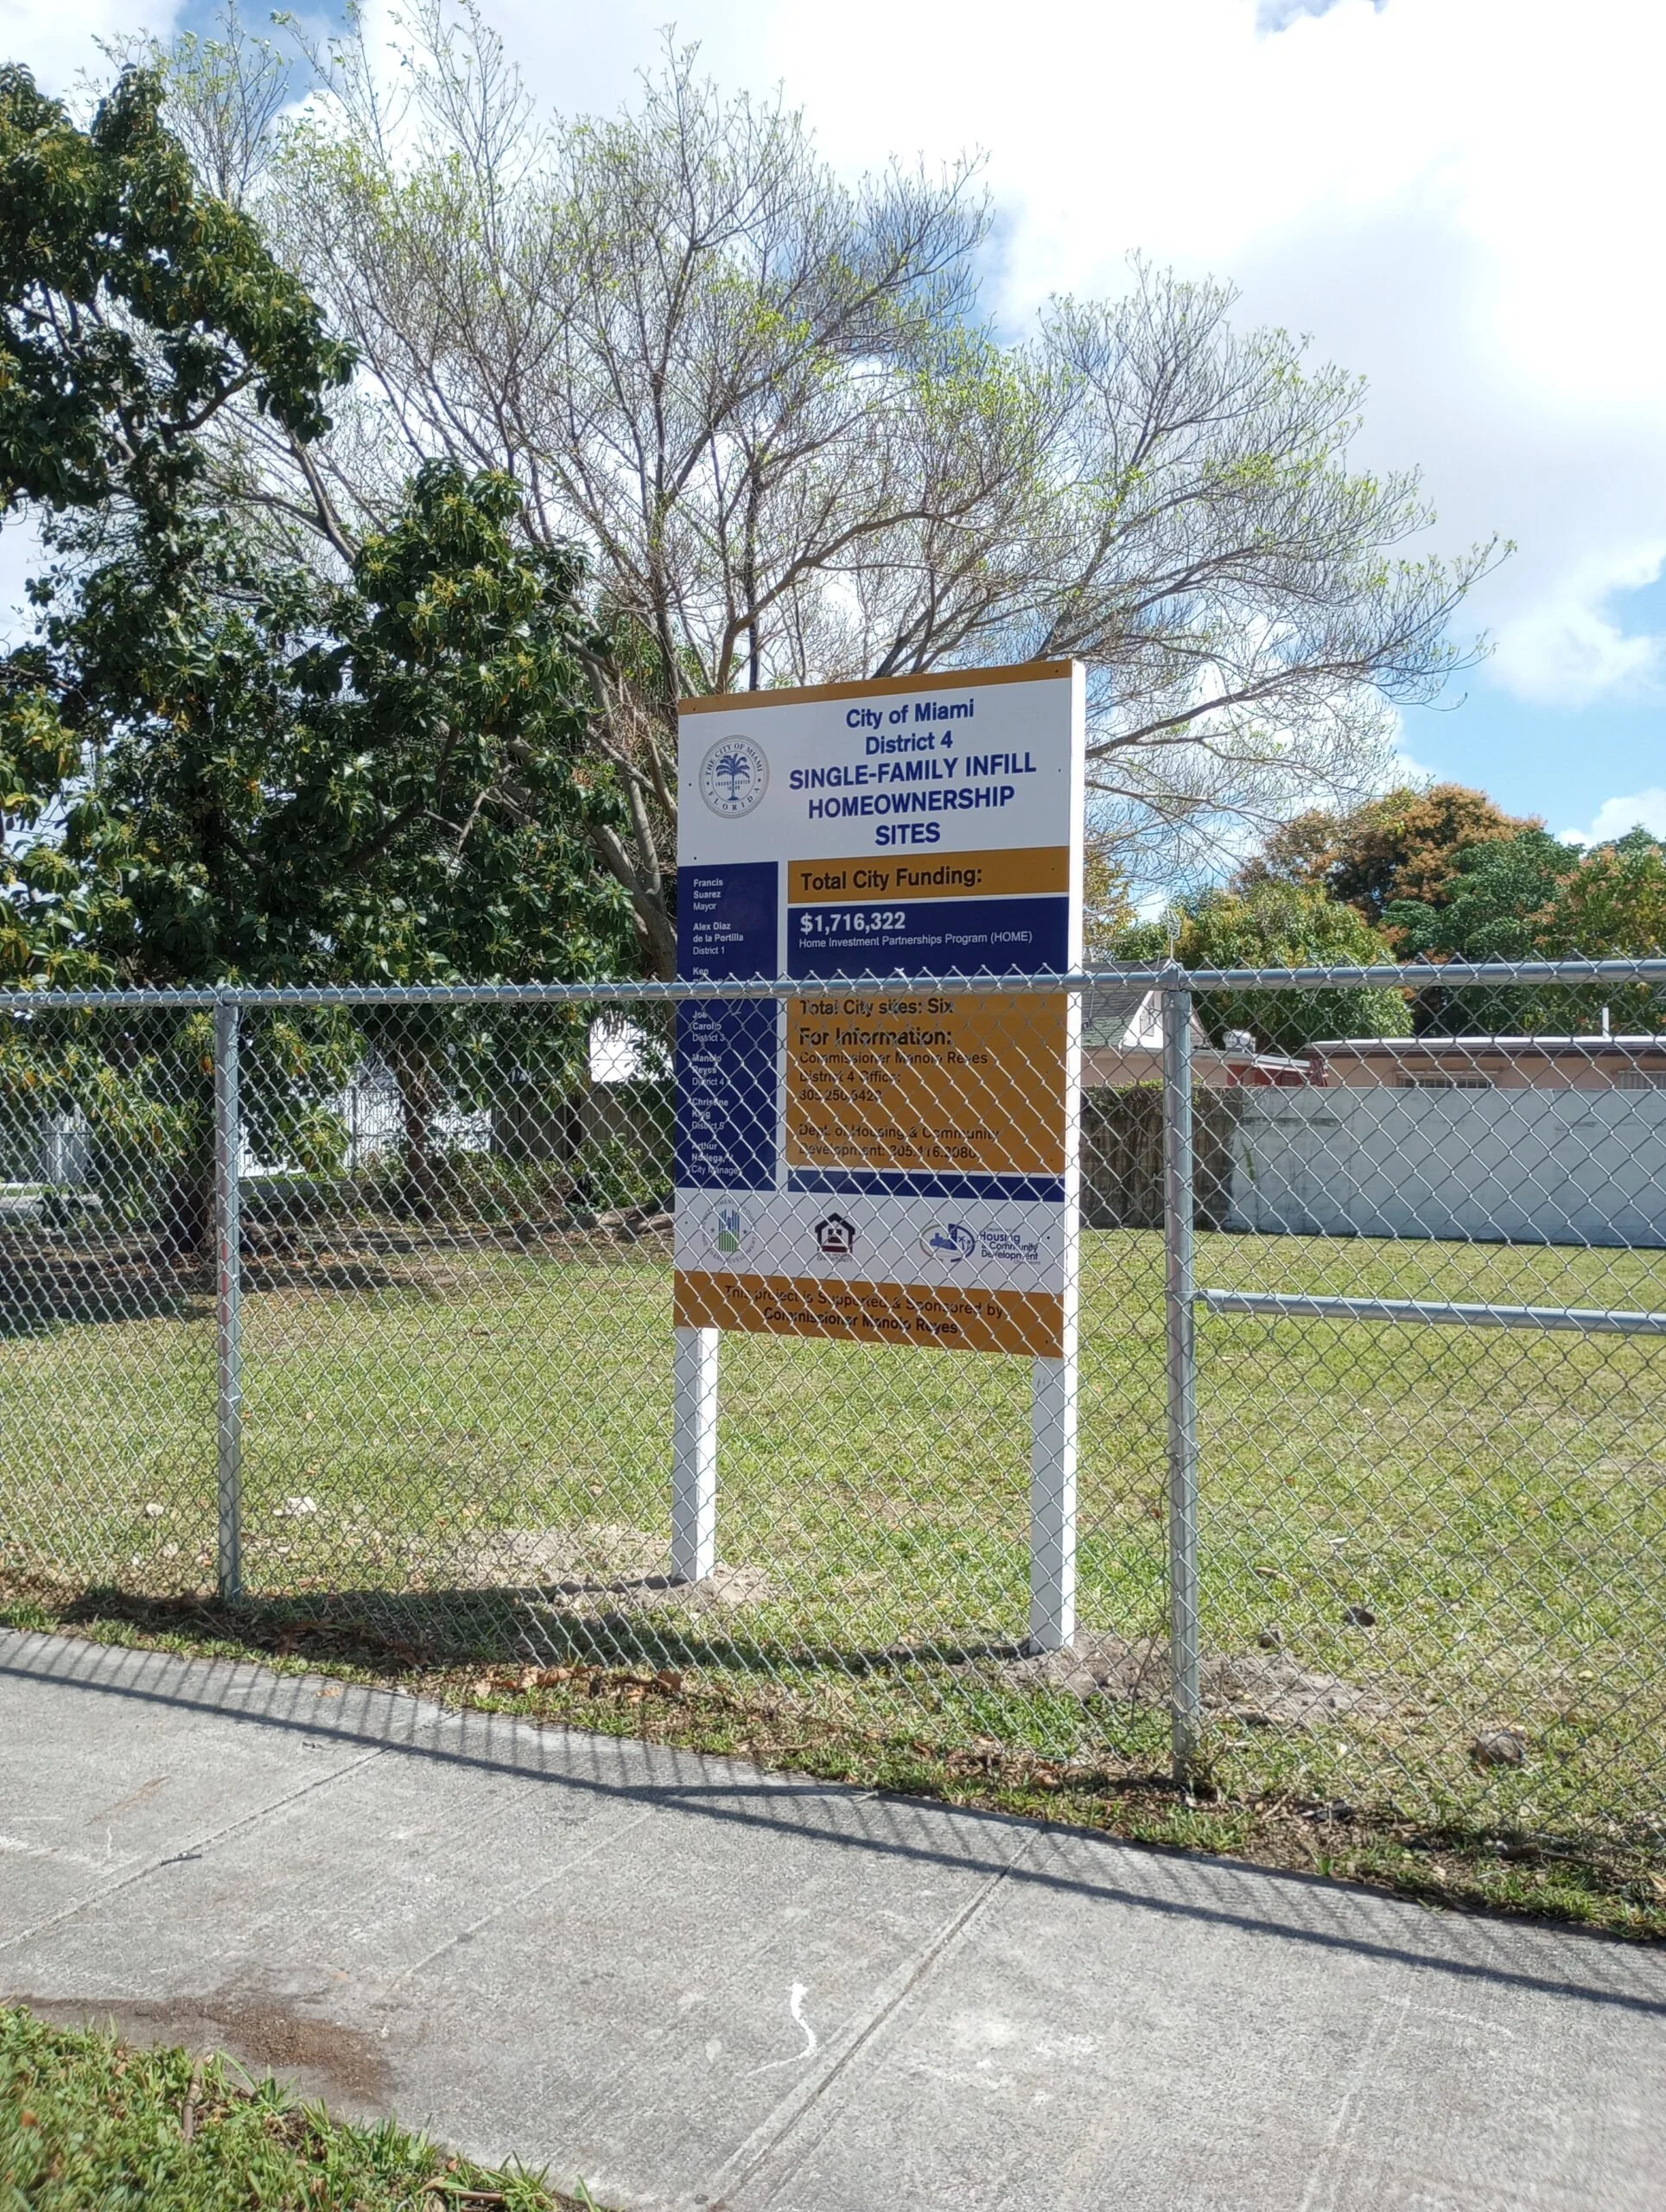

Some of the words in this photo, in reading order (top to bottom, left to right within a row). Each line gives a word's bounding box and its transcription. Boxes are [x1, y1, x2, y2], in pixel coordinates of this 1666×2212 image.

[846, 707, 883, 730] City
[888, 704, 909, 724] of
[914, 698, 975, 722] Miami
[866, 732, 935, 755] District
[940, 730, 953, 748] 4
[789, 757, 958, 790] SINGLE-FAMILY
[966, 752, 1037, 778] INFILL
[809, 785, 1014, 819] HOMEOWNERSHIP
[874, 822, 940, 846] SITES
[693, 878, 723, 887] Francis
[800, 871, 847, 891] Total
[853, 869, 889, 892] City
[896, 866, 982, 887] Funding:
[693, 902, 716, 912] Mayor
[799, 912, 906, 935] $1,716,322
[693, 934, 703, 943] de
[715, 933, 744, 942] Portilla
[799, 938, 826, 948] Home
[829, 937, 880, 947] Investment
[881, 934, 942, 946] Partnerships
[944, 932, 988, 945] Program
[990, 931, 1033, 944] (HOME)
[693, 946, 719, 955] District
[693, 967, 709, 976] Ken
[799, 999, 838, 1015] Total
[843, 999, 874, 1017] City
[927, 997, 954, 1014] Six
[799, 1027, 830, 1045] For
[836, 1027, 951, 1045] Information:
[799, 1052, 891, 1064] Commissioner
[947, 1052, 988, 1065] Rees
[848, 1071, 854, 1082] 4
[692, 1097, 728, 1106] Chrisne
[799, 1090, 882, 1101] 305250542
[909, 1127, 918, 1138] &
[691, 1166, 706, 1175] City
[708, 1166, 741, 1176] Manage
[980, 1231, 1021, 1244] Housig
[893, 1296, 901, 1309] &
[987, 1303, 1003, 1319] by
